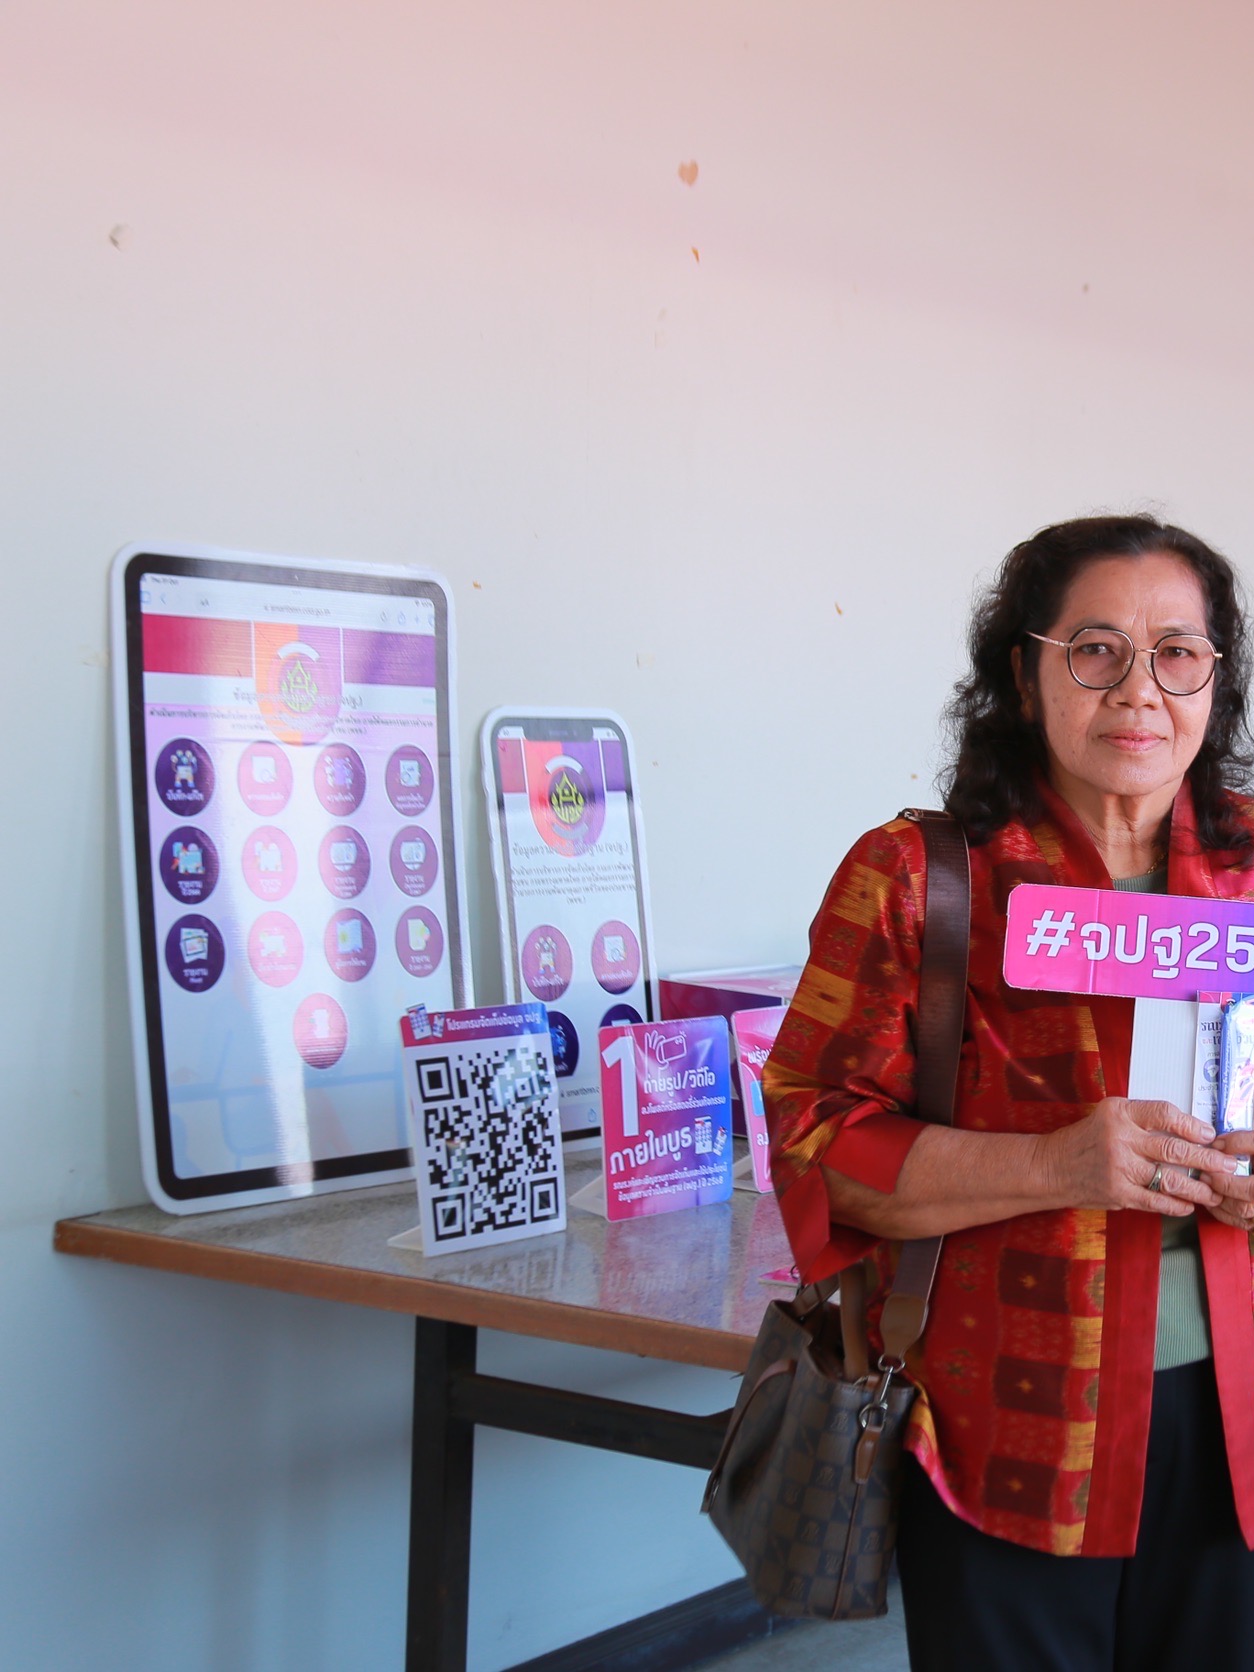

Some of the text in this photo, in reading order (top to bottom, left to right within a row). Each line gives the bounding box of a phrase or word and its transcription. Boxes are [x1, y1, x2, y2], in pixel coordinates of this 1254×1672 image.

[601, 1036, 640, 1137] 1
[610, 1126, 693, 1175] ภายในบูธ
